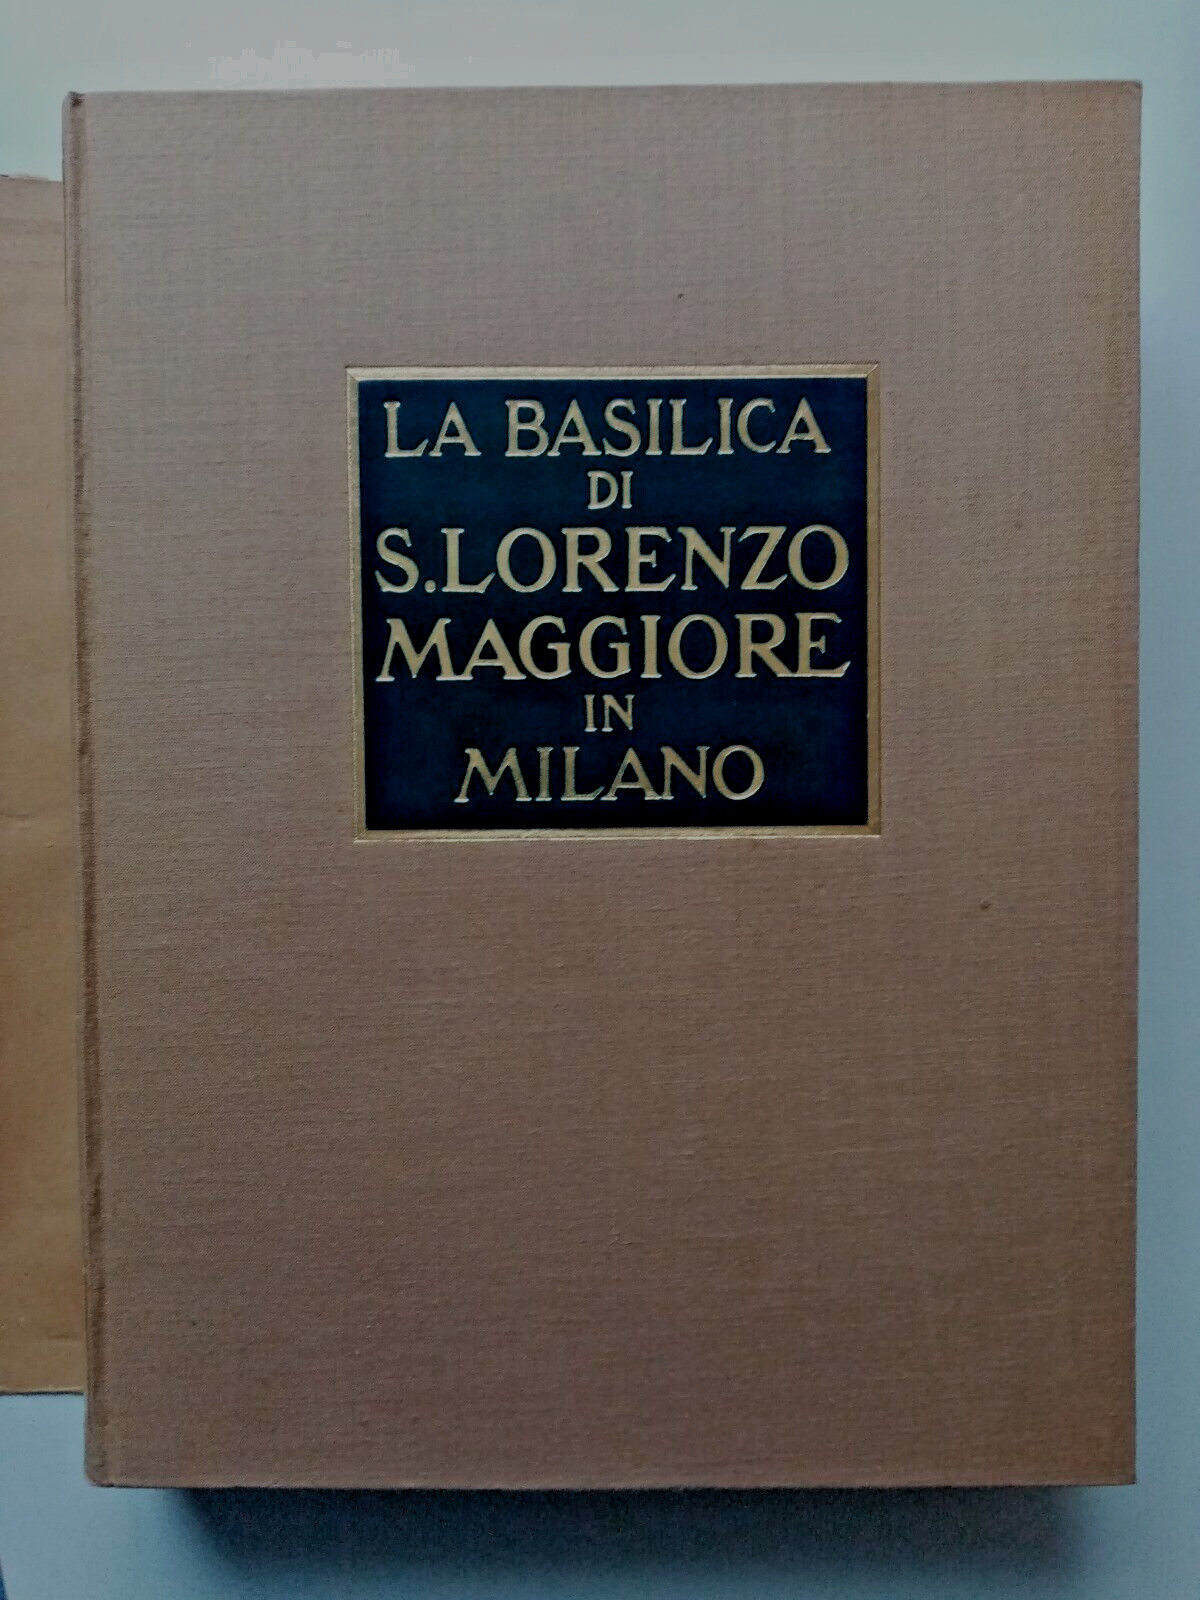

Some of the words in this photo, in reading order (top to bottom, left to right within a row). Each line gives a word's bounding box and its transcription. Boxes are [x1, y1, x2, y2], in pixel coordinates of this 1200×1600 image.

[383, 401, 482, 458] LA
[504, 398, 832, 458] BASILICA
[586, 470, 634, 510] DI
[375, 612, 851, 682] MAGGIORE
[584, 693, 635, 733] IN
[454, 744, 765, 803] MILANO
